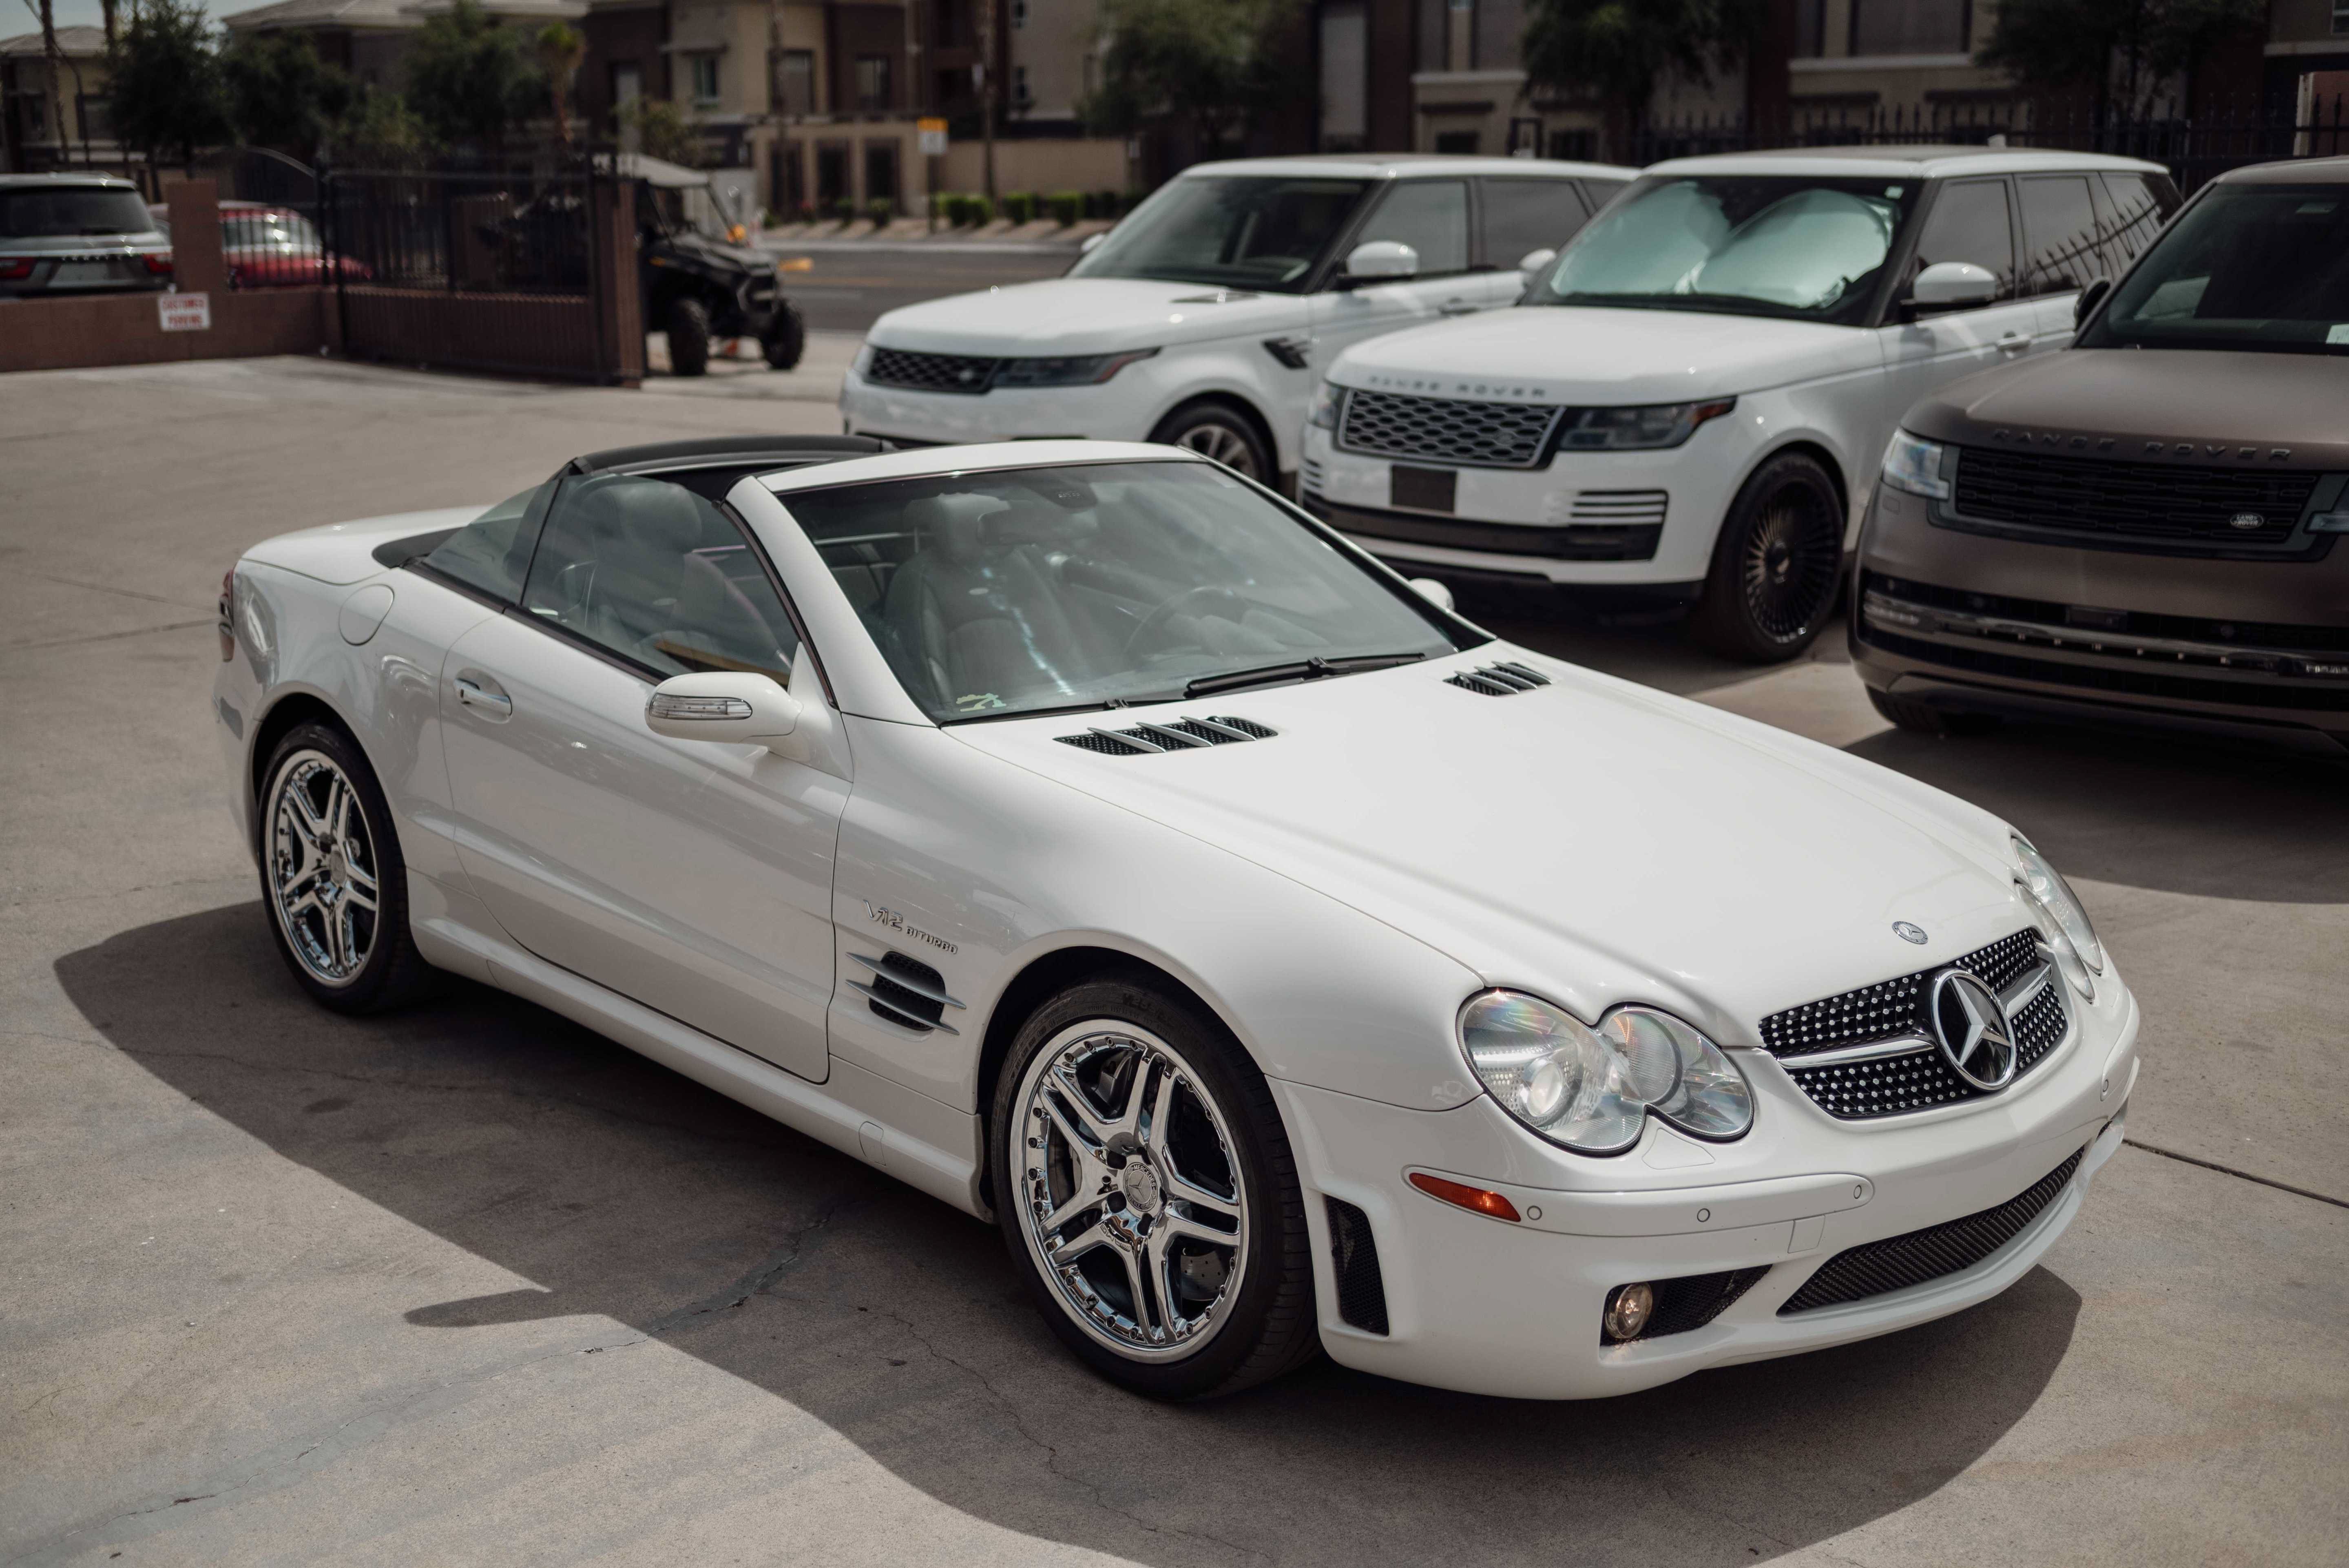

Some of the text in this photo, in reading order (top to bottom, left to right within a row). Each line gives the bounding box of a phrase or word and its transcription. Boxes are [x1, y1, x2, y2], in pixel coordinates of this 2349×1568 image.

[1456, 383, 1546, 397] ROVER
[1993, 429, 2291, 460] RANGE ROVER
[863, 899, 958, 954] V12 BITURBO
[1133, 1165, 1156, 1188] MERCEDES
